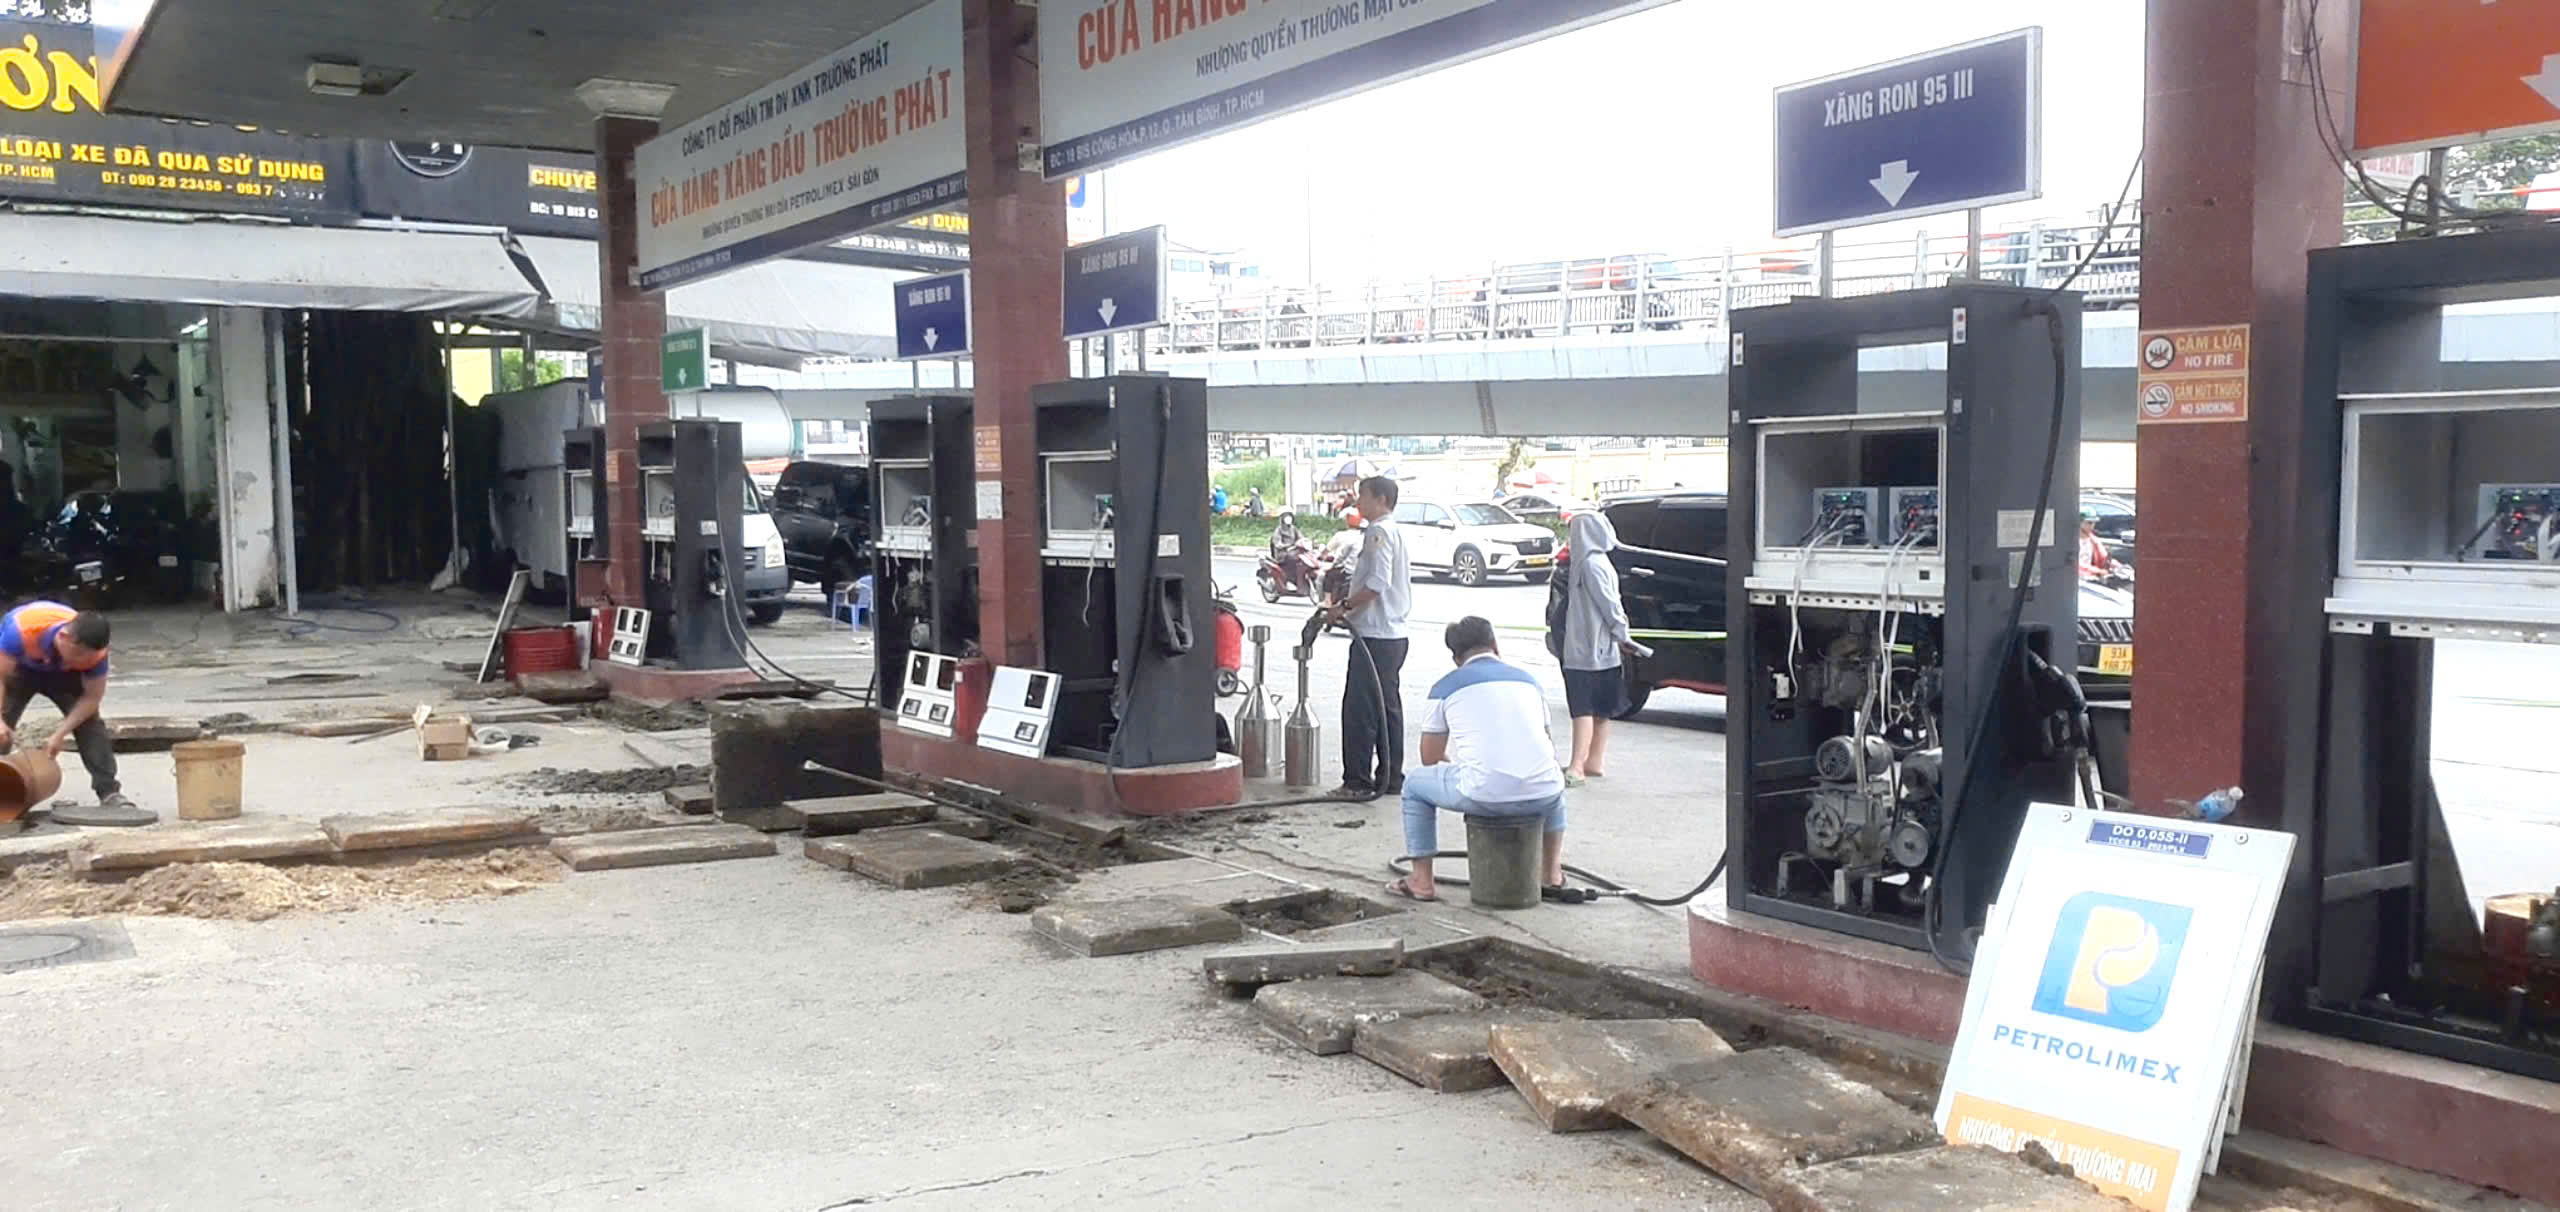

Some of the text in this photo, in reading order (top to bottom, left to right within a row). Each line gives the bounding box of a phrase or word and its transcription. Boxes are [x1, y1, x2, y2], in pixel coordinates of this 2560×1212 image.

[1194, 38, 1249, 77] NHƯỢNG
[1250, 20, 1297, 60] QUYỀN
[1300, 1, 1360, 42] THƯƠNG
[682, 129, 704, 158] CÔNG
[706, 123, 717, 146] TY
[859, 38, 890, 77] PHÁT
[1824, 67, 1974, 128] XĂNG RON 95 III
[0, 138, 325, 183] LOẠI XE ĐÃ QUA SỬ DỤNG
[651, 175, 679, 229] CỬA
[682, 167, 720, 217] HÀNG
[723, 148, 767, 201] XĂNG
[813, 97, 889, 168] TRƯỜNG
[894, 64, 952, 136] PHÁT
[20, 165, 56, 179] HCM
[128, 173, 156, 187] 090
[179, 177, 223, 193] 23456
[236, 181, 262, 196] 093
[789, 179, 845, 212] PETROLIMEX
[2183, 352, 2235, 369] NO FIRE
[2112, 825, 2134, 837] DO
[1993, 1024, 2182, 1084] PETROLIMEX
[2066, 1143, 2126, 1183] THƯƠNG
[2127, 1160, 2159, 1196] MẠI
